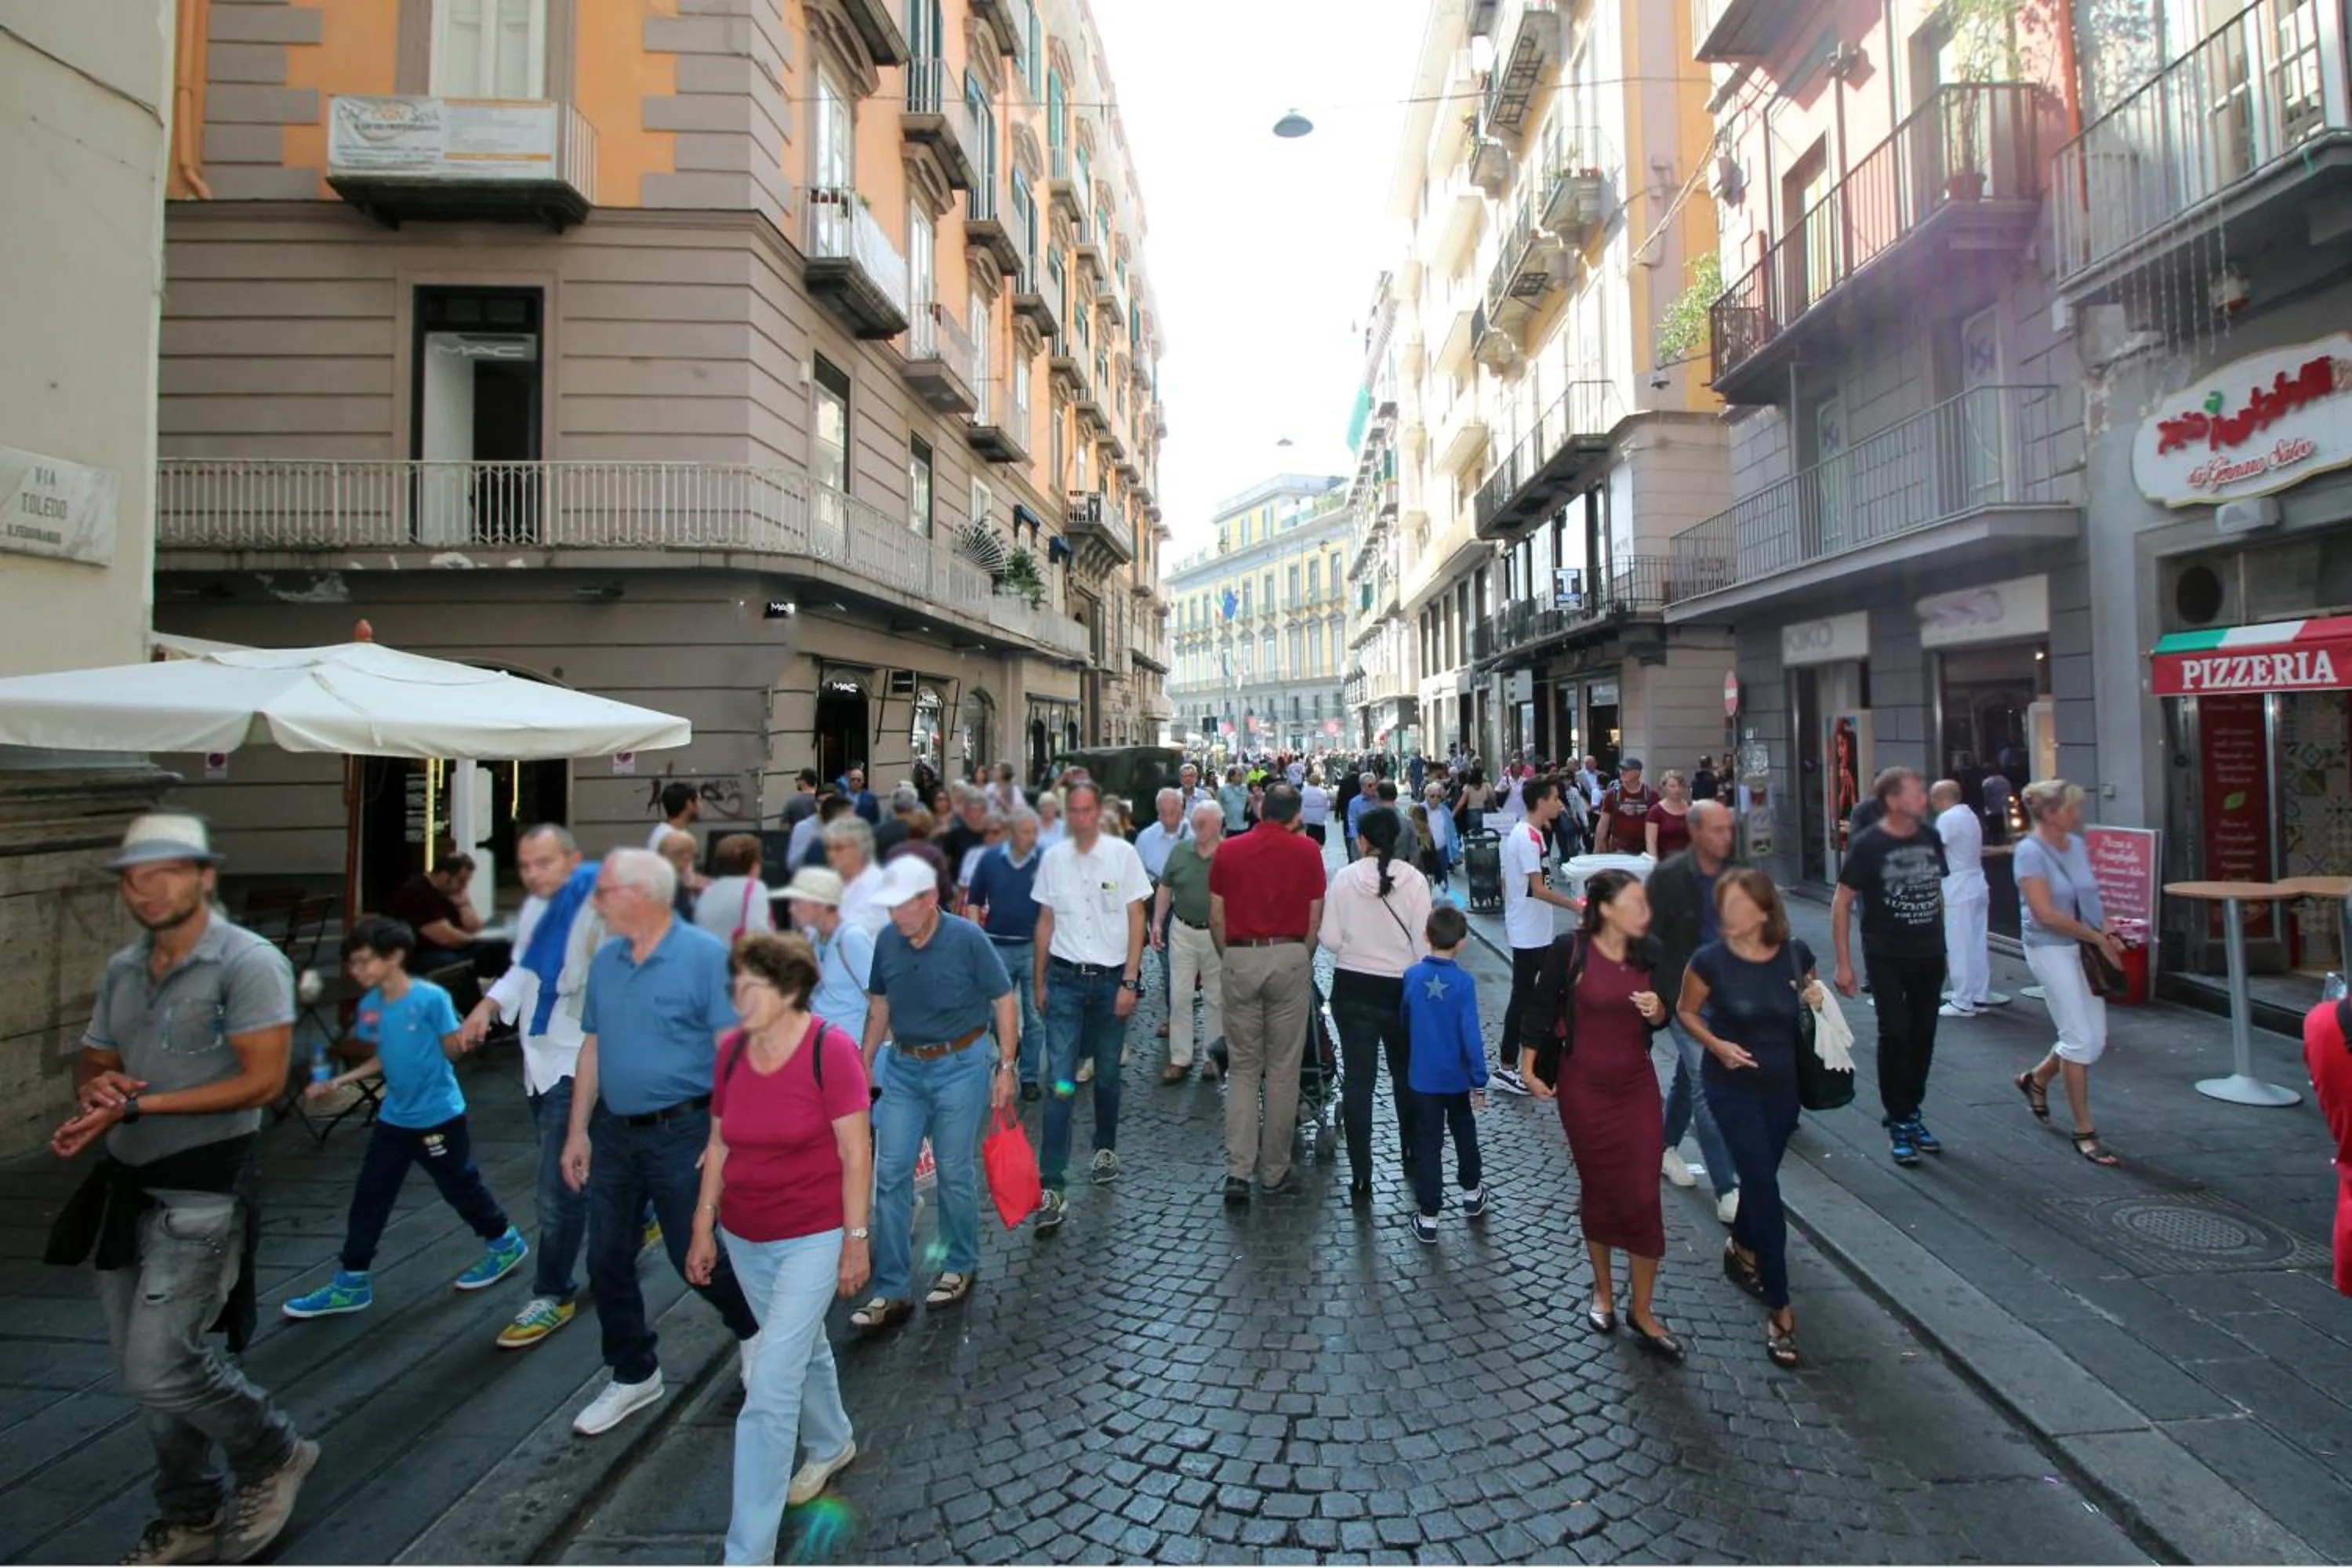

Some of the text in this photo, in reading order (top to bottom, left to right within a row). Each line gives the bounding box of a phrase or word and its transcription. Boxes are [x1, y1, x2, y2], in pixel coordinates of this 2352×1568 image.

[438, 345, 524, 358] MAC
[35, 466, 56, 485] VIA
[22, 492, 67, 521] TOLEDO
[2181, 650, 2339, 690] PIZZERIA
[833, 681, 858, 693] MAC
